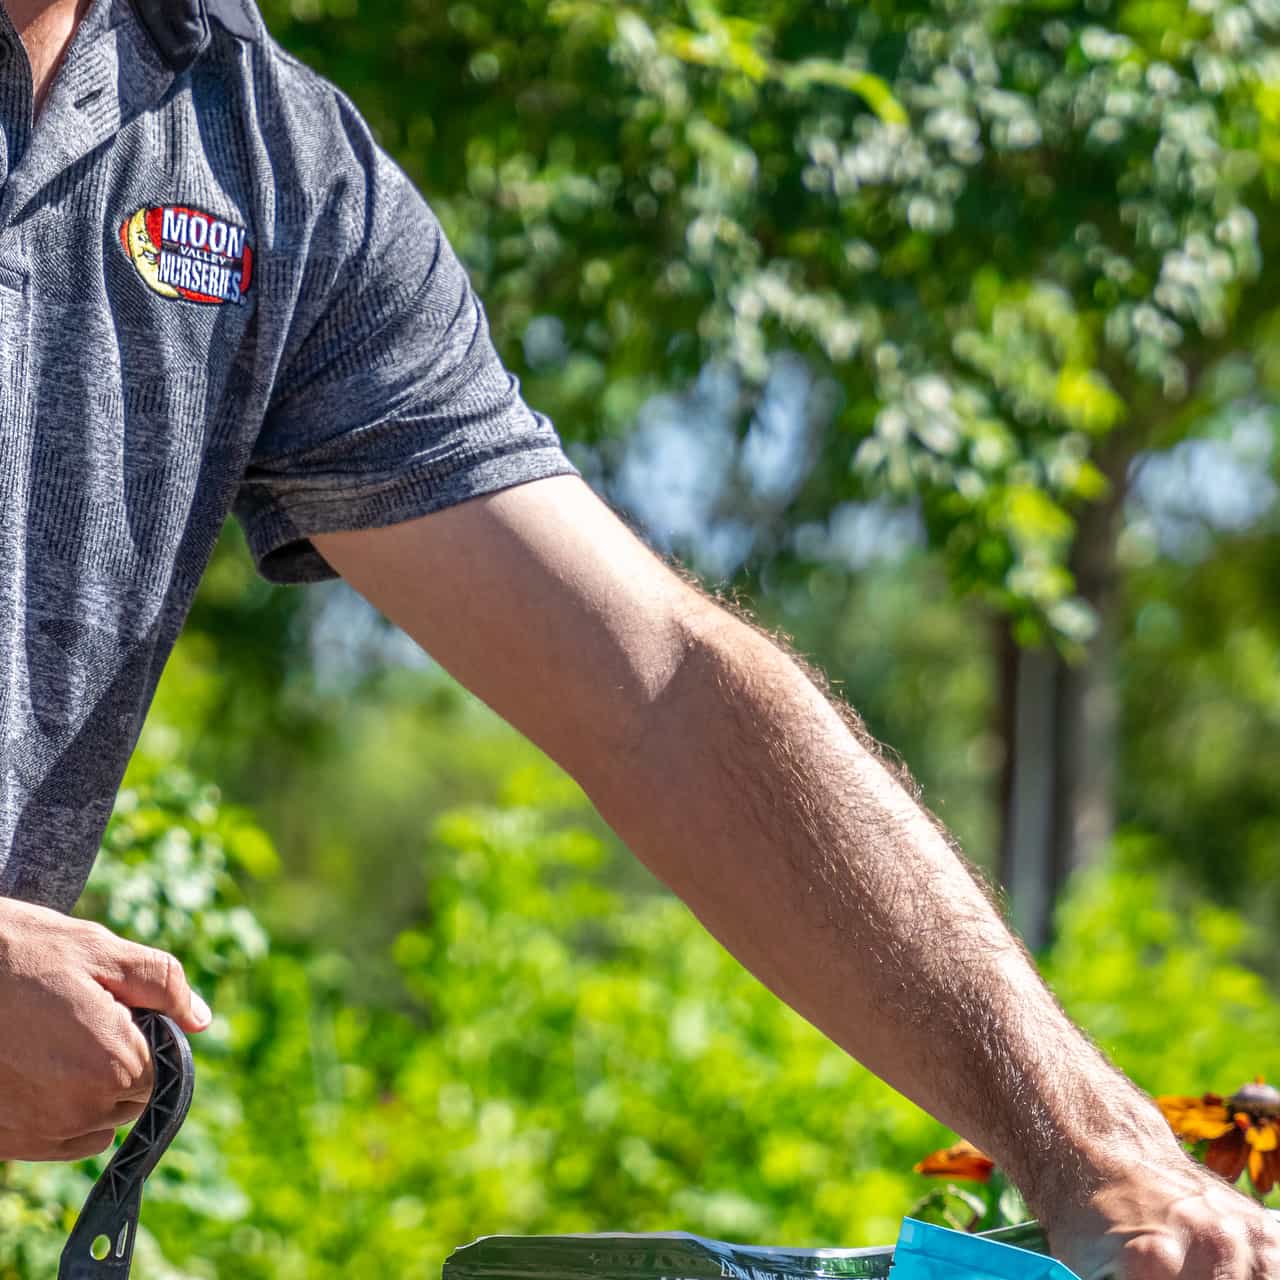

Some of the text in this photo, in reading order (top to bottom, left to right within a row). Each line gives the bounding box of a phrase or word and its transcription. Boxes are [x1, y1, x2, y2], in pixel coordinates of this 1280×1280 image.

[162, 209, 245, 259] MOON
[179, 246, 227, 266] VALLEY
[159, 252, 242, 303] NURSERIES
